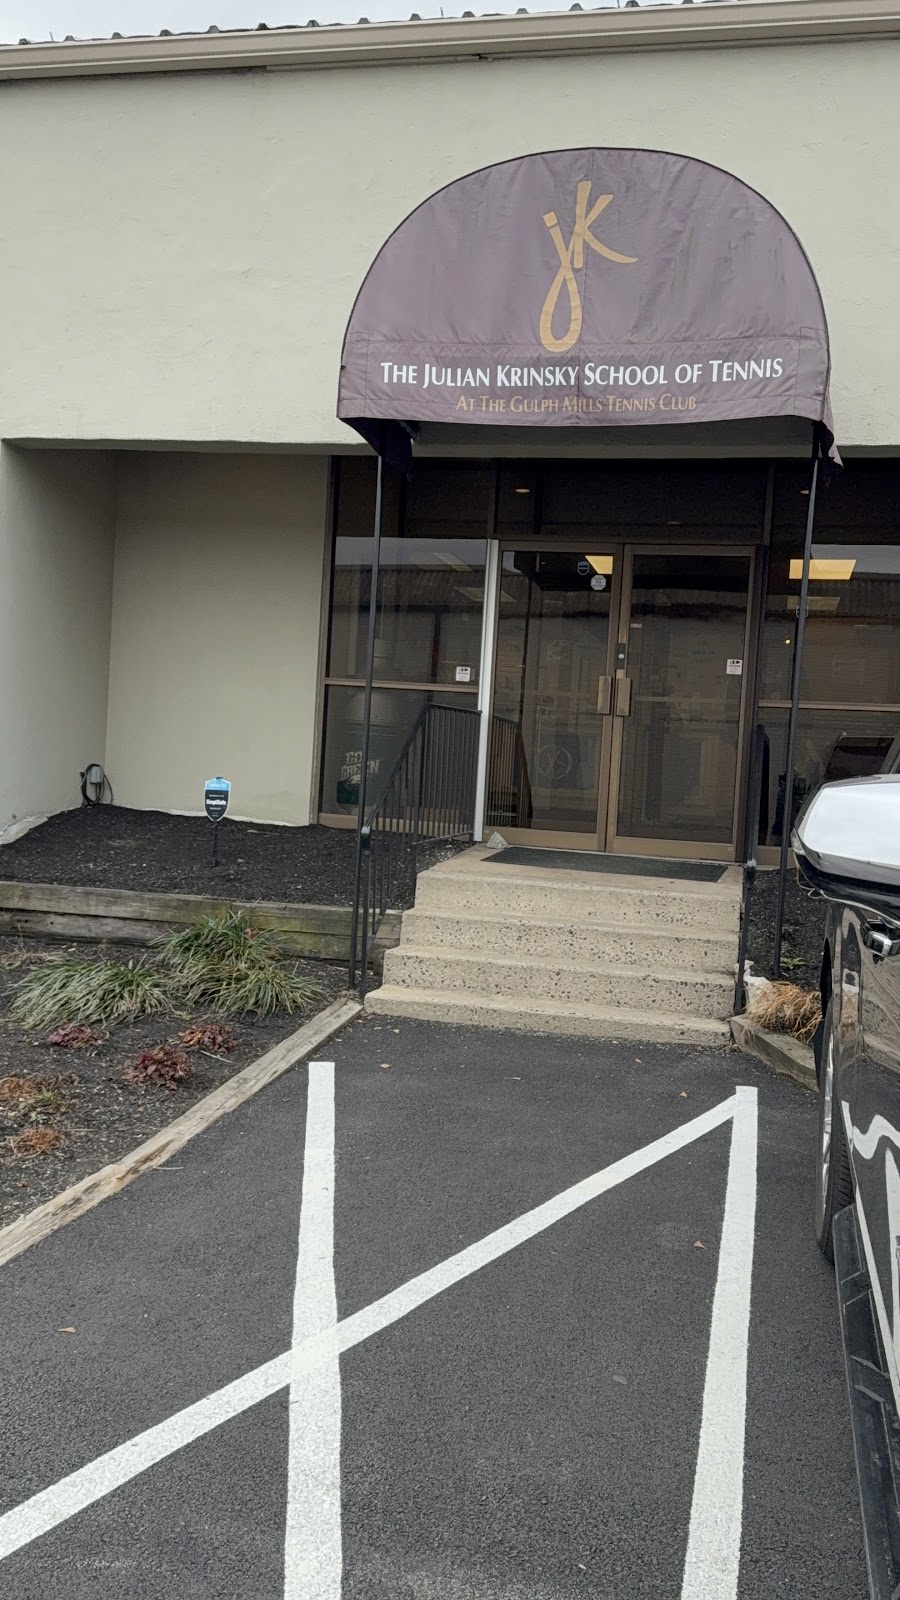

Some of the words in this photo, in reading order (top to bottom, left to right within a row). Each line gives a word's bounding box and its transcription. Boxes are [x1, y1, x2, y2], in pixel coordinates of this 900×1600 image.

[381, 362, 418, 384] THE
[422, 363, 490, 388] JULIAN
[497, 365, 579, 387] KRINSKY
[584, 362, 668, 386] SCHOOL
[674, 363, 702, 384] OF
[709, 358, 783, 383] TENNIS
[456, 395, 476, 411] AT
[479, 395, 506, 412] THE
[510, 396, 558, 413] GULPH
[562, 396, 602, 413] MILLS
[606, 395, 656, 412] TENNIS
[659, 393, 697, 411] CLUB
